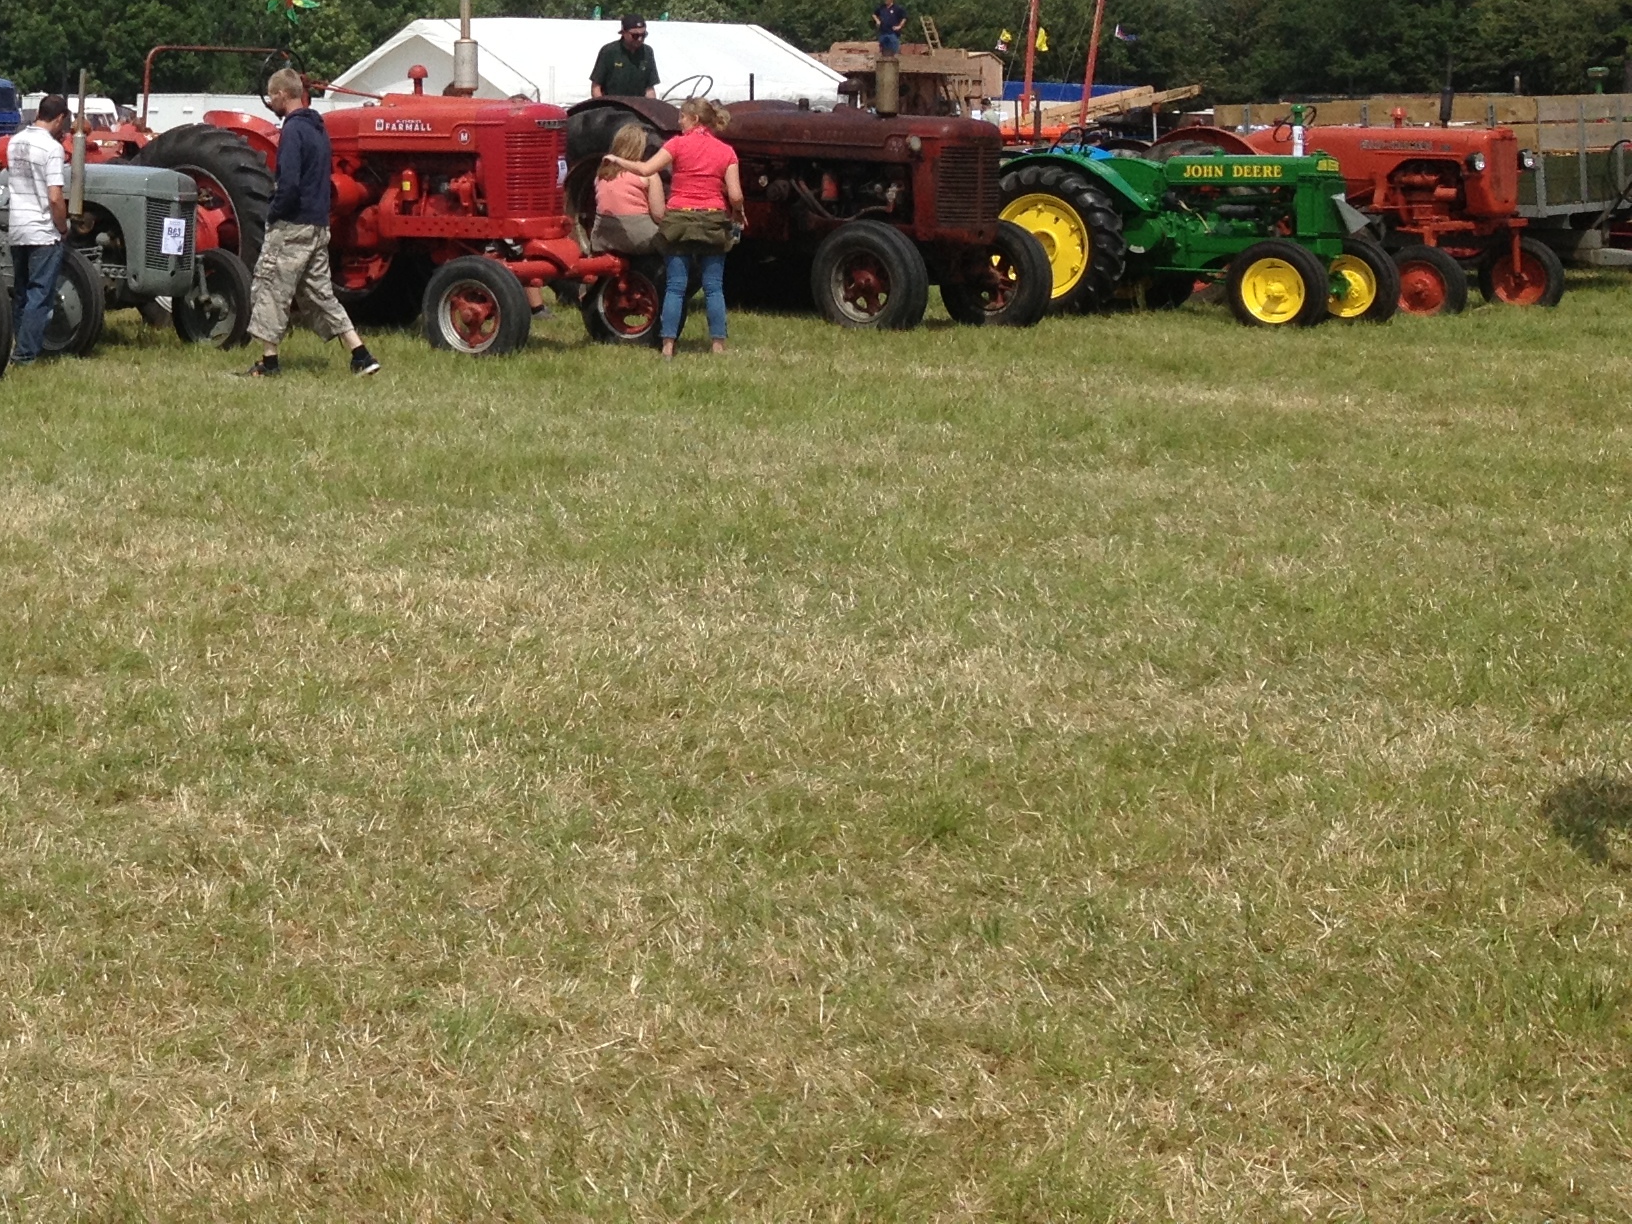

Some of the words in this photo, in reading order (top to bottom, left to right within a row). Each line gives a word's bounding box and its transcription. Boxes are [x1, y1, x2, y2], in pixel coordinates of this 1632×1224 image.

[385, 123, 432, 132] FARMALL
[1184, 165, 1223, 178] JOHN
[1233, 165, 1282, 178] DEERE
